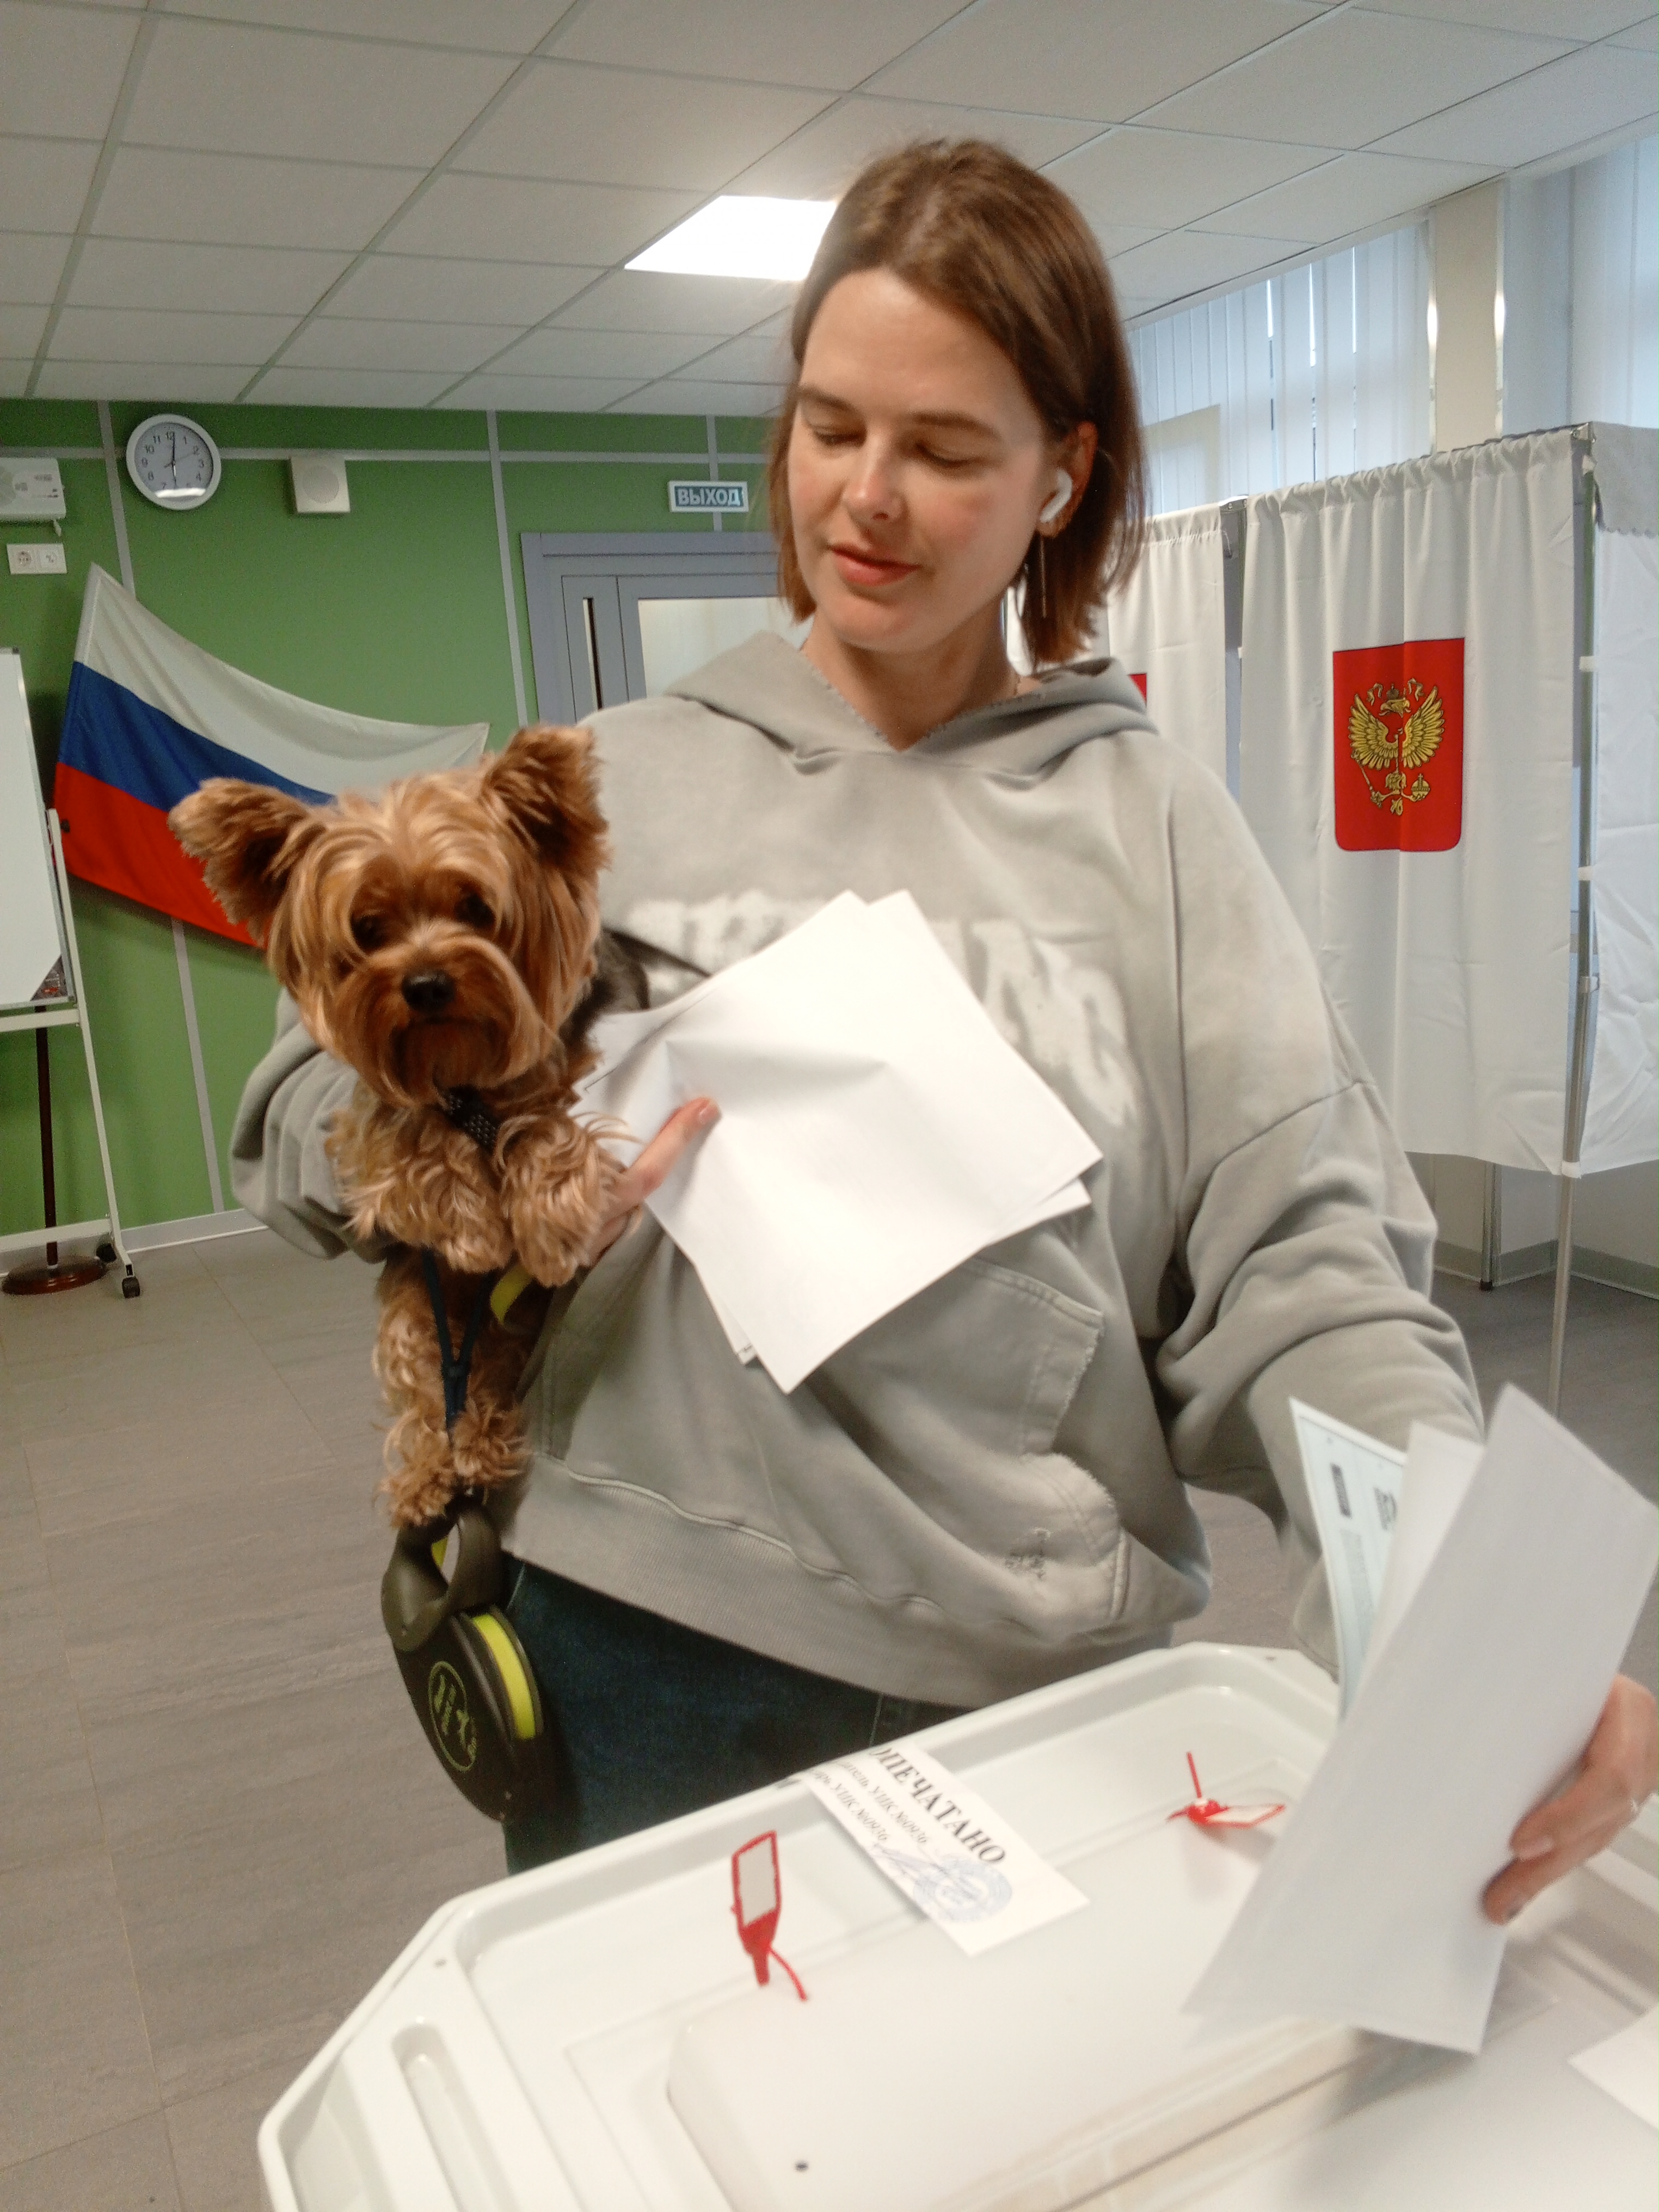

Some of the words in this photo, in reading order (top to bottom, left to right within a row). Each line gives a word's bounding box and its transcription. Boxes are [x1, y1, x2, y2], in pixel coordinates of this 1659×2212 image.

[153, 435, 161, 445] 11
[183, 436, 188, 445] 1
[143, 444, 155, 454] 10
[192, 445, 200, 456] 2
[142, 457, 148, 468] 9
[198, 458, 205, 469] 3
[148, 471, 155, 481] 8
[195, 471, 202, 482] 4
[677, 488, 740, 506] ВЫХОД
